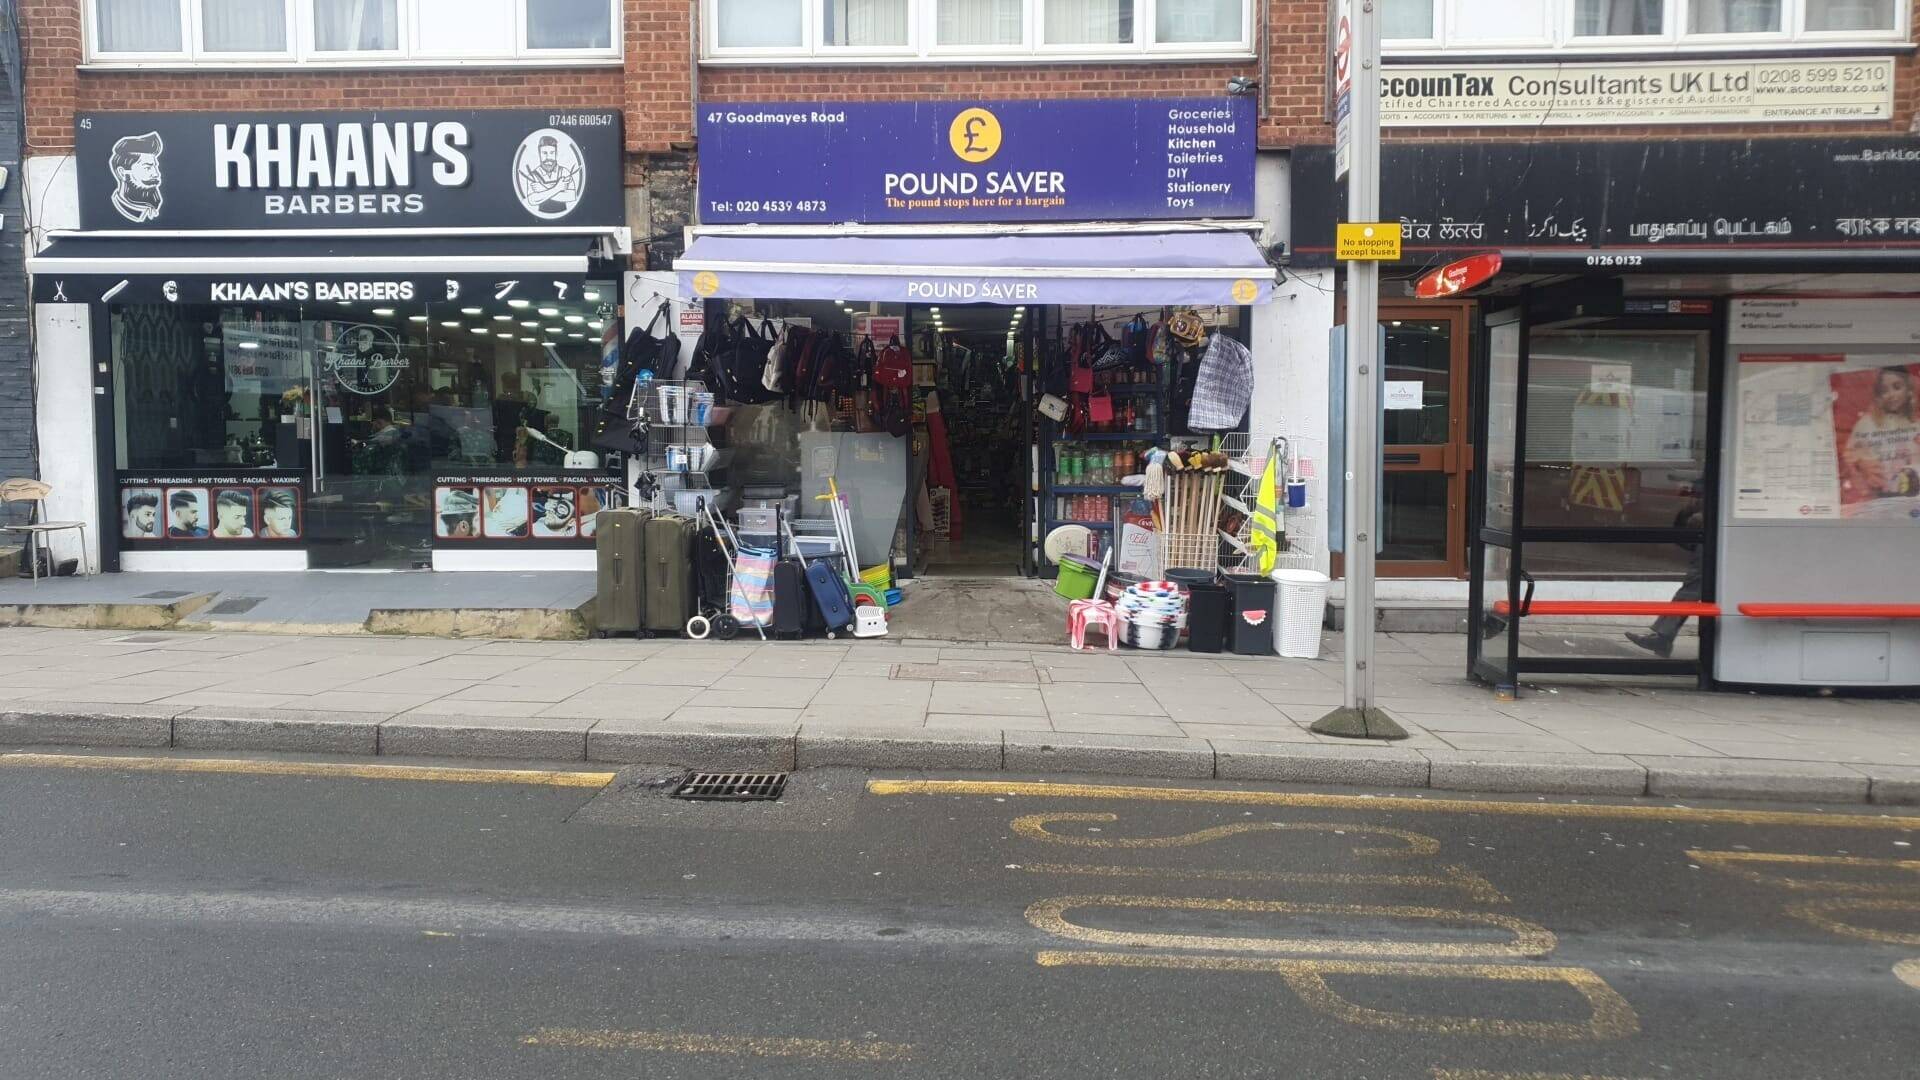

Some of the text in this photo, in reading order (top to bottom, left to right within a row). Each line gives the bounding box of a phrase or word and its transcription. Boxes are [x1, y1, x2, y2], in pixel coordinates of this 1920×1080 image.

[1760, 66, 1885, 84] 0208 599 5210
[1380, 70, 1750, 98] ccounTax Consultants UK Ltd
[1755, 83, 1888, 95] www.acountax.co.uk
[1427, 97, 1500, 109] Chartered
[1503, 96, 1592, 109] Accountants
[1685, 93, 1753, 105] Auditors
[707, 111, 845, 126] 47 Goodmayes Road
[1168, 107, 1231, 120] Groceries
[1380, 113, 1400, 121] UDITS
[1413, 112, 1451, 120] ACCOUNTS
[1476, 112, 1508, 120] RETURNS
[1519, 112, 1532, 120] VAT
[1764, 106, 1863, 118] ENTRANCE AT REAR
[79, 118, 92, 131] 45
[549, 114, 612, 126] 07446 600547
[1168, 122, 1235, 135] Household
[1168, 138, 1216, 149] Kitchen
[214, 121, 469, 190] KHAAN'S
[1168, 152, 1224, 164] Toiletries
[1168, 168, 1188, 179] DIY
[885, 171, 1066, 195] POUND SAVER
[1167, 181, 1231, 194] Stationery
[265, 193, 424, 215] BARBERS
[711, 201, 827, 212] Tel: 020 4539 4873
[886, 197, 906, 208] The
[908, 197, 941, 210] pound
[943, 198, 969, 209] stops
[972, 197, 996, 207] here
[998, 197, 1013, 207] for
[1025, 195, 1066, 208] bargain
[1166, 196, 1194, 209] Toys
[1629, 217, 1792, 243] பாதுகாப்பு பெட்டகம்
[1358, 238, 1394, 248] stopping
[1341, 248, 1396, 257] except buses
[1586, 255, 1642, 266] 0126 0132
[210, 280, 414, 301] KHAAN'S BARBERS
[908, 281, 1038, 299] POUND SAVER
[370, 353, 410, 368] Barber
[436, 476, 622, 484] CUTTING THREADING HOT TOWEL FACIAL WAXING
[1008, 812, 1640, 1040] STOP
